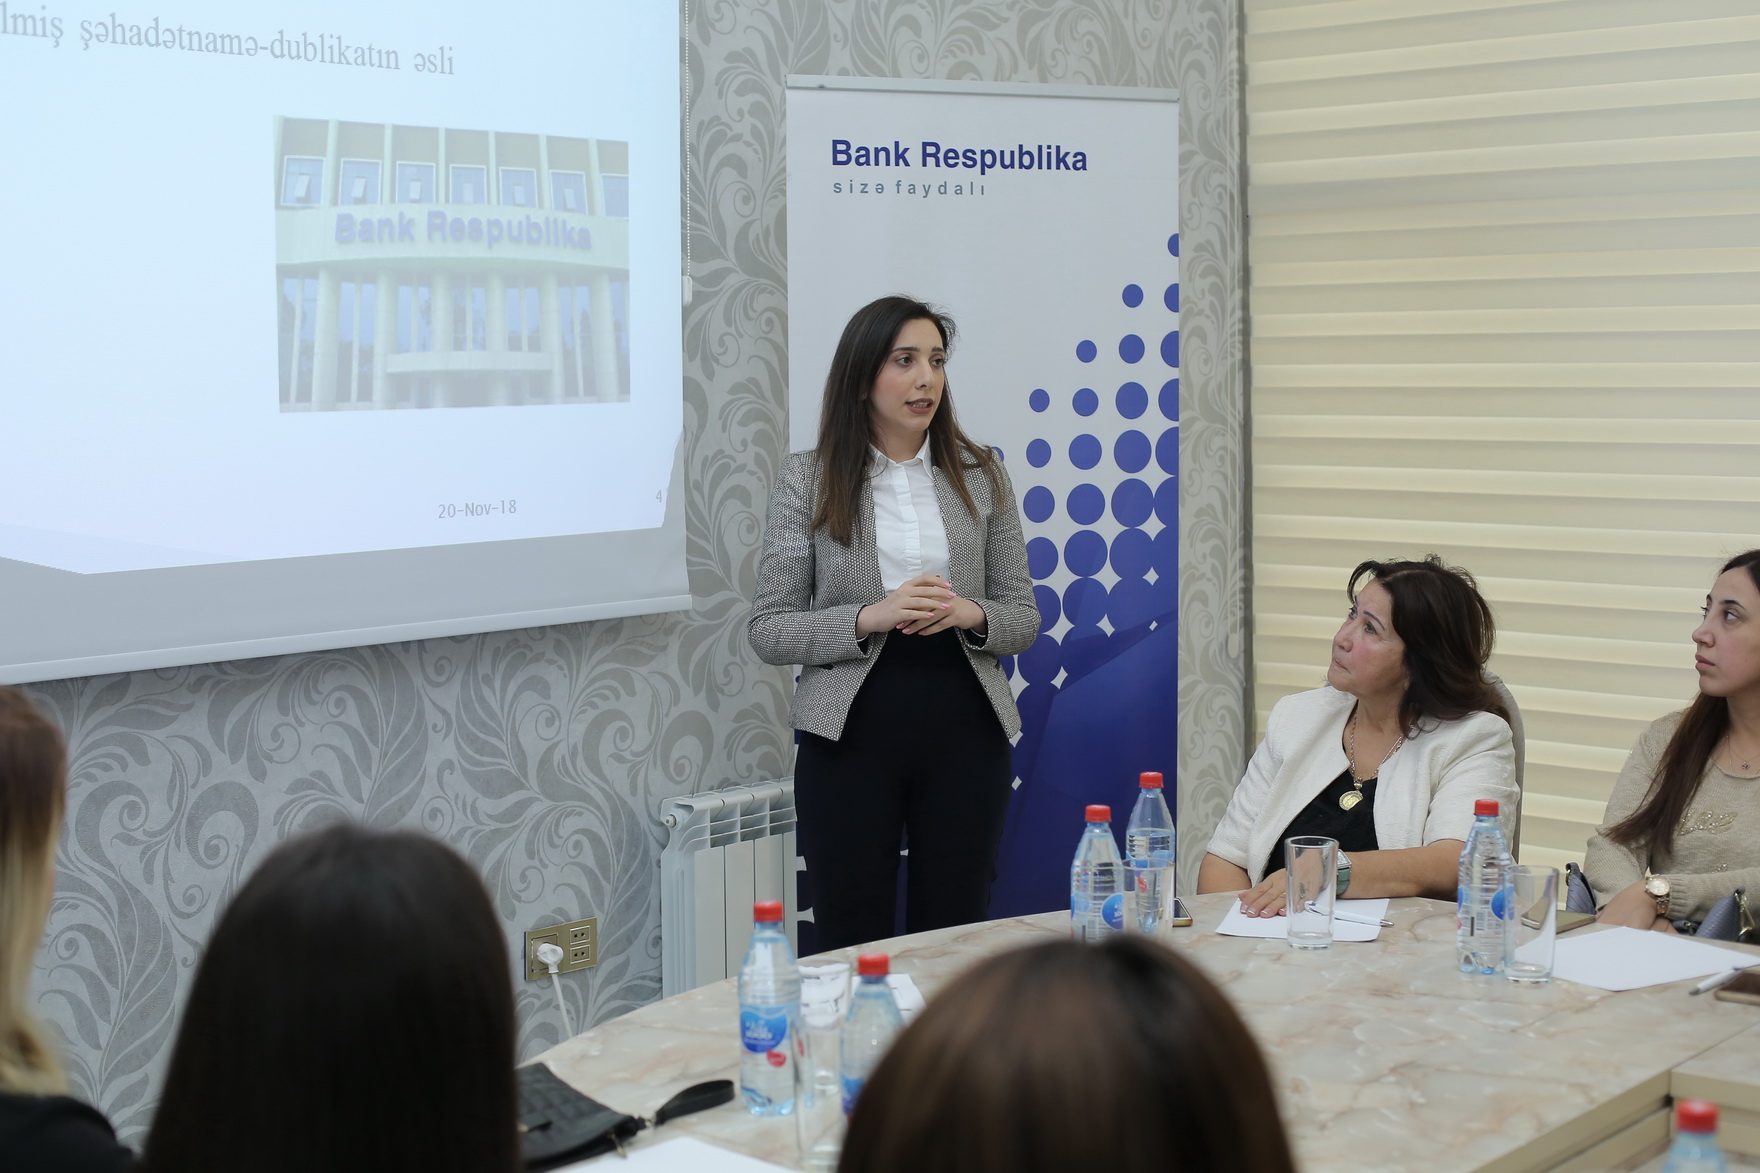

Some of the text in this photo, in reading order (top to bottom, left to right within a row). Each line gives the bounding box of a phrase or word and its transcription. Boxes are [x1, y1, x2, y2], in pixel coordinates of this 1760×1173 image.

[0, 0, 455, 75] lmiş şəhadətnamə-dublikatın əsli
[831, 139, 1088, 176] Bank Respublika
[833, 179, 985, 198] sizə faydalı
[334, 210, 593, 251] Bank Respublika
[438, 499, 517, 519] 20-Nov-18
[655, 489, 663, 503] 4
